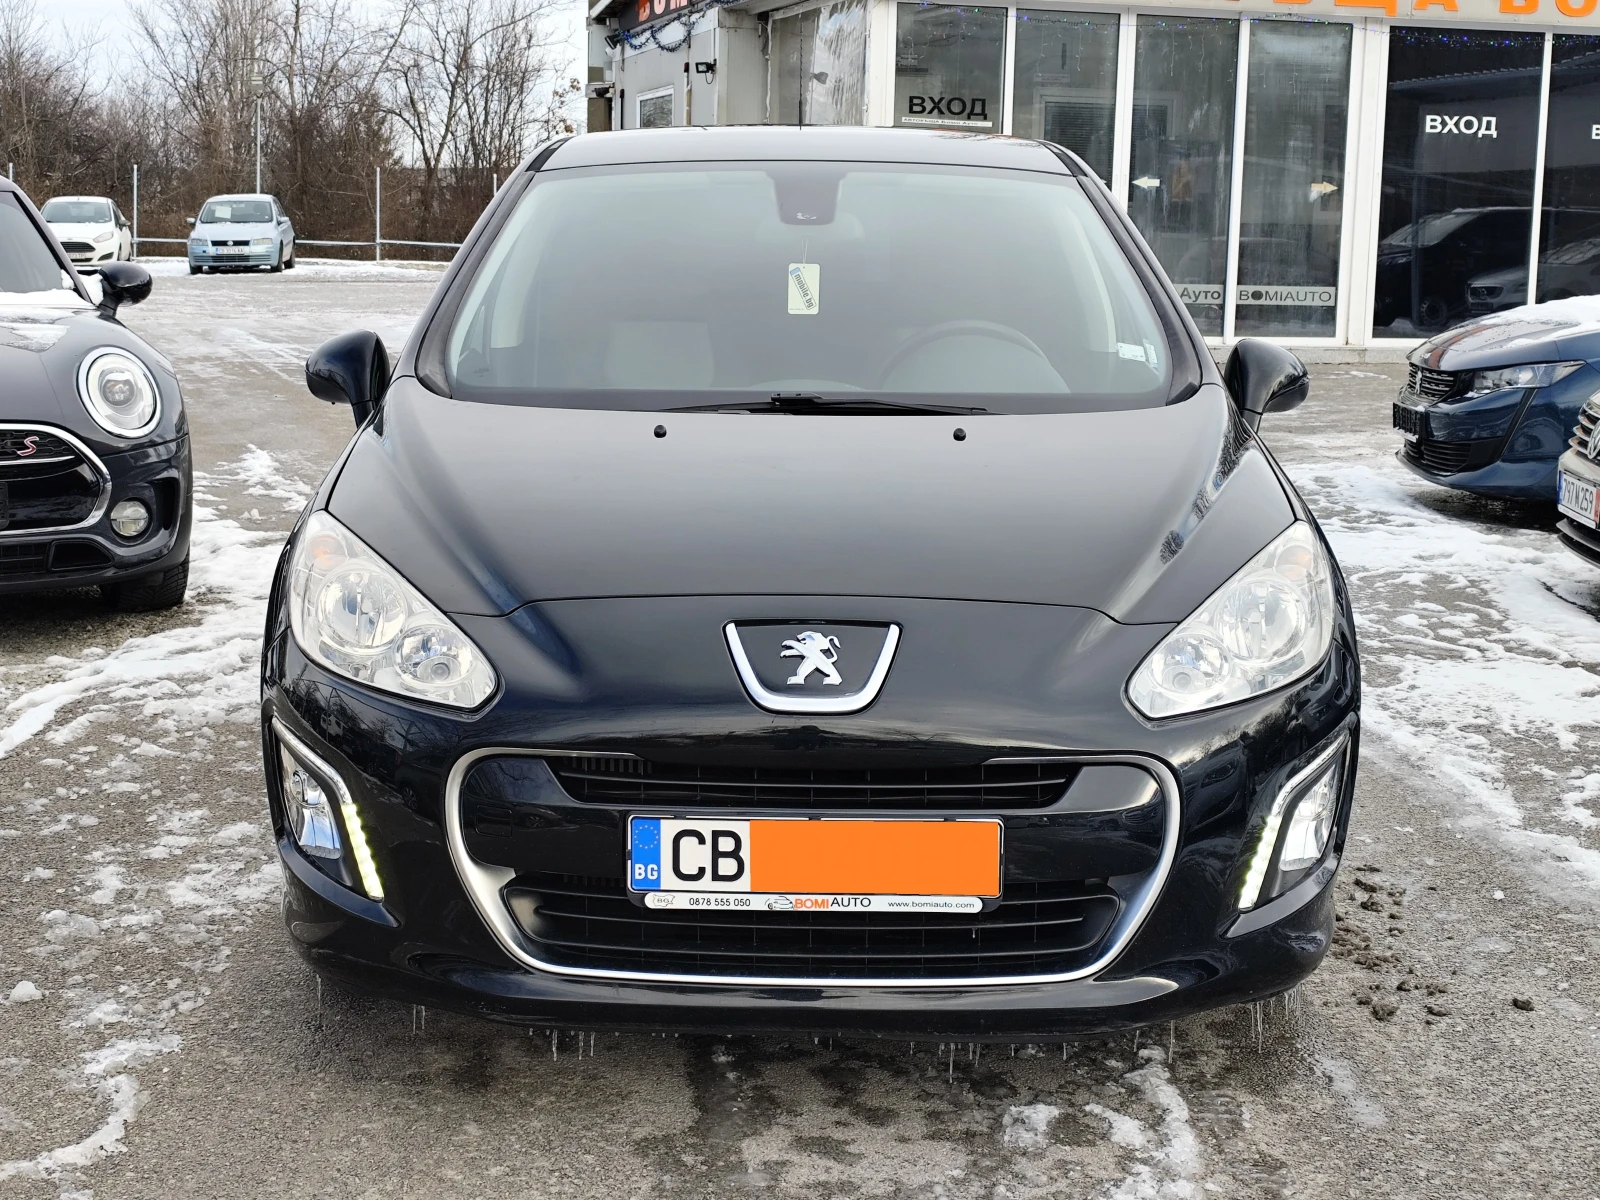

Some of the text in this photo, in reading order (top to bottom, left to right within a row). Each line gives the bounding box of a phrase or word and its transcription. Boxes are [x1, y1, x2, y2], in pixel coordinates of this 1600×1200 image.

[909, 96, 987, 120] ВХОД
[1425, 114, 1498, 138] ВХОД
[793, 273, 814, 308] mobile.bg
[1180, 287, 1222, 303] Ауто
[17, 436, 39, 456] S
[671, 829, 745, 882] CB
[634, 863, 659, 880] BG
[689, 897, 751, 907] 0878 555 050
[887, 900, 975, 909] www.bomiauto.com
